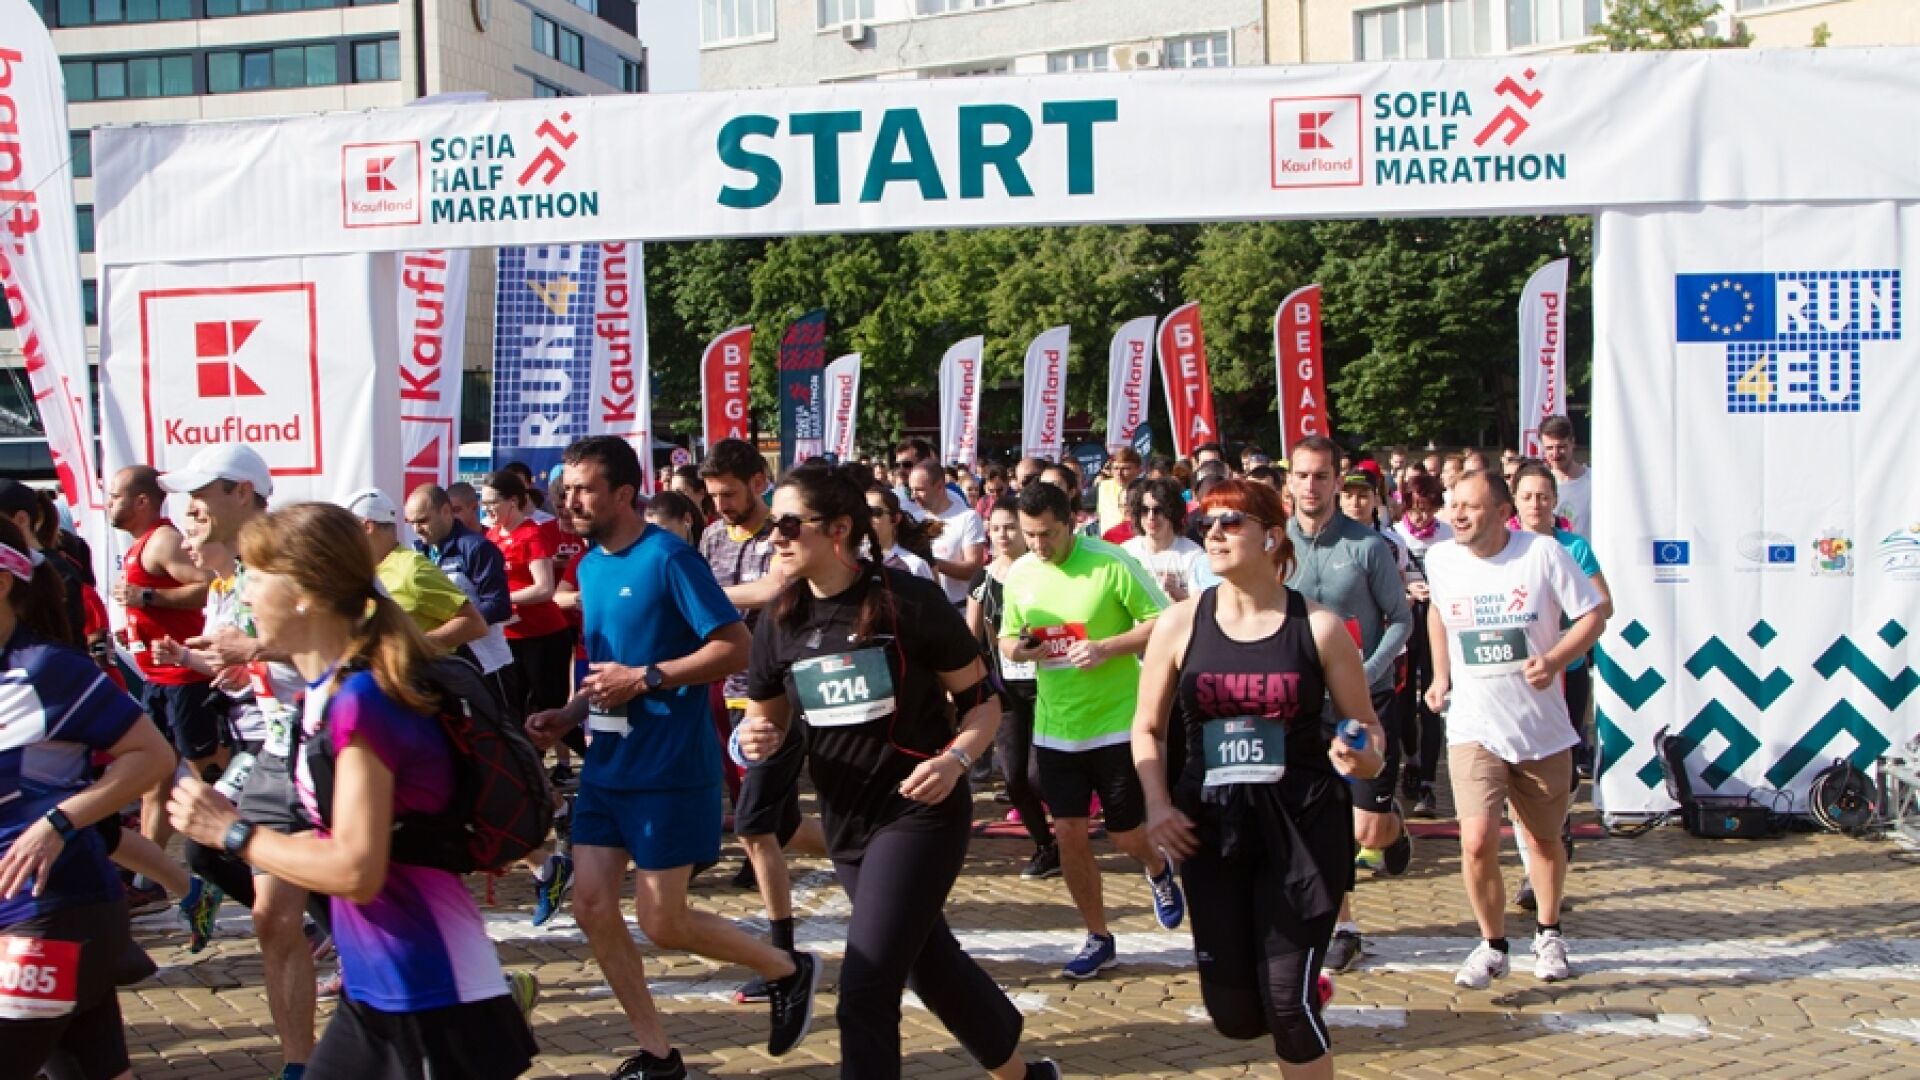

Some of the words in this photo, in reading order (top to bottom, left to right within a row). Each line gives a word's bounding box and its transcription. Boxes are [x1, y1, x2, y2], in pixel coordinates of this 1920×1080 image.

[1374, 91, 1472, 119] SOFIA
[431, 134, 515, 162] SOFIA
[1375, 124, 1457, 152] HALF
[717, 98, 1118, 209] START
[1281, 158, 1353, 173] Kaufland
[432, 166, 503, 193] HALF
[1375, 153, 1566, 185] MARATHON
[351, 198, 413, 214] Kaufland
[432, 191, 598, 224] MARATHON
[1777, 280, 1891, 331] RUN
[399, 248, 447, 401] Kaufl
[1540, 291, 1558, 419] aufland
[1122, 340, 1144, 440] Kaufland
[1736, 350, 1850, 404] 4EU
[958, 359, 974, 449] Kaufland
[1041, 350, 1060, 445] Kaufland
[164, 414, 300, 445] Kaufland
[1474, 593, 1506, 604] SOFIA
[1475, 605, 1501, 615] HALF
[1476, 612, 1538, 625] MARATHON
[1043, 636, 1076, 654] 087
[1474, 645, 1513, 662] 1308
[817, 677, 870, 704] 1214
[1196, 672, 1300, 702] SWEAT
[1218, 739, 1264, 763] 1105
[0, 962, 58, 993] 085
